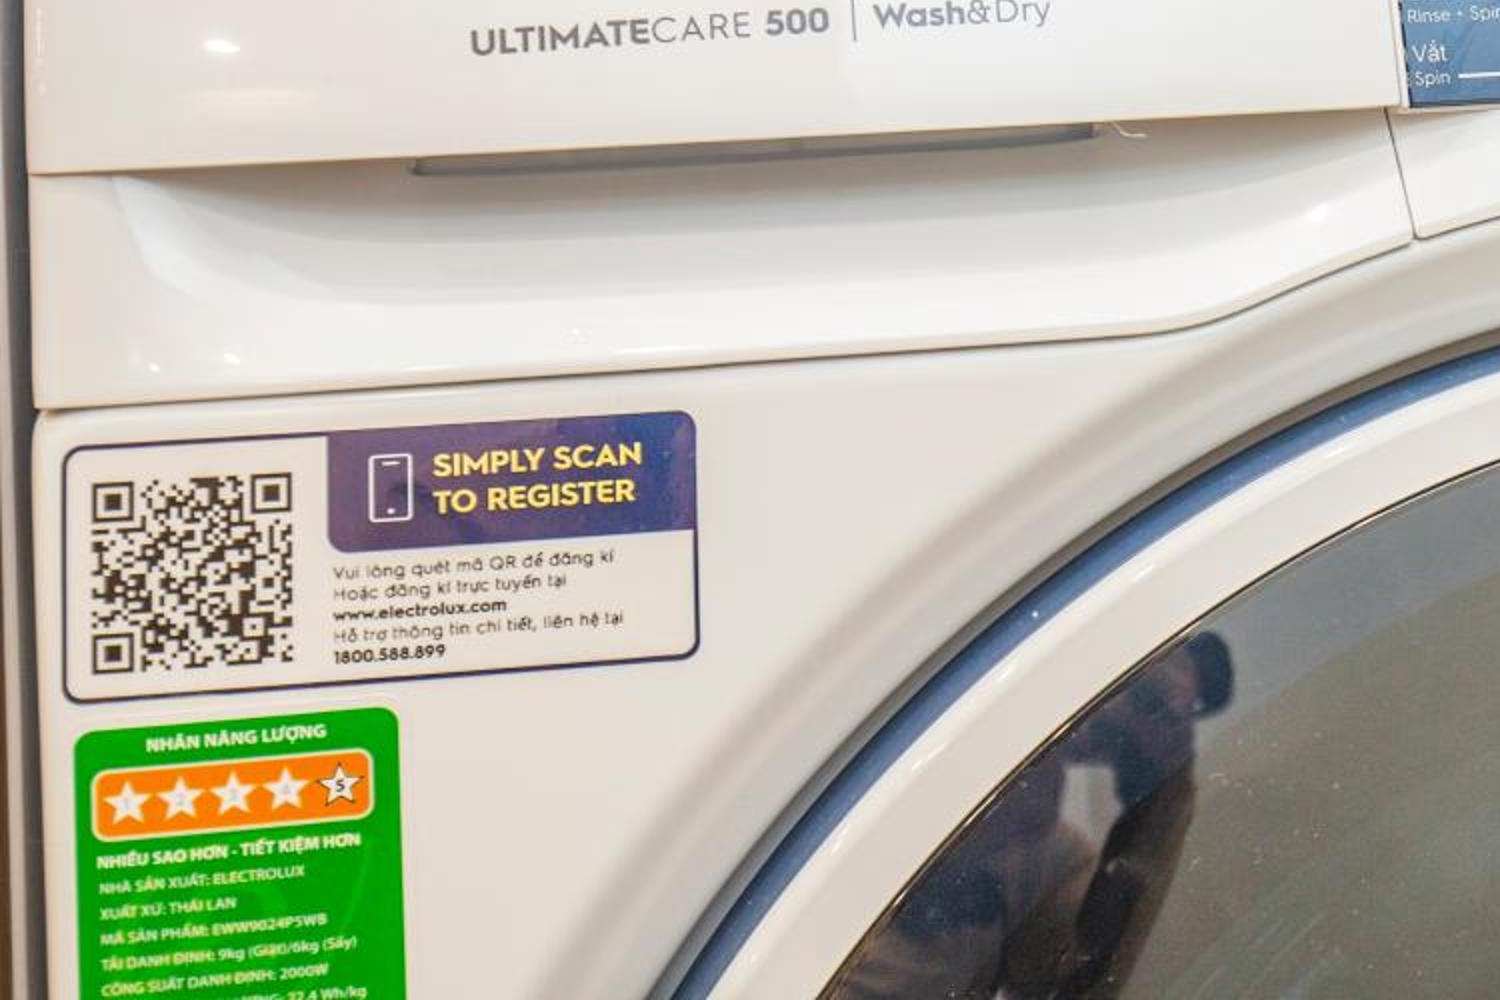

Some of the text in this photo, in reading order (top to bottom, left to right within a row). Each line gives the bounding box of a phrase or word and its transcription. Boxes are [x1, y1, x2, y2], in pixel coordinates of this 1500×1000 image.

[1407, 9, 1452, 23] Rinse
[470, 6, 830, 56] ULTIMATECARE 500
[1415, 71, 1451, 88] Spin
[432, 441, 642, 478] SIMPLY SCAN
[432, 478, 637, 515] TO REGISTER
[333, 566, 360, 580] Vui
[366, 563, 405, 580] lòng
[411, 561, 450, 578] quét
[456, 558, 483, 572] mã
[489, 555, 517, 570] QR
[333, 588, 378, 602] Hoặc
[333, 599, 507, 622] www.electrolux.com
[392, 625, 444, 641] thông
[449, 621, 470, 636] tin
[475, 620, 500, 635] chi
[579, 612, 599, 628] hệ
[333, 643, 447, 665] 1800.588.899
[261, 723, 327, 744] LƯỢNG
[152, 848, 187, 866] SAO
[190, 844, 229, 862] HƠN
[240, 837, 275, 856] TIẾT
[278, 836, 321, 855] KIỆM
[323, 832, 362, 849] HƠN
[212, 864, 305, 885] ELECTROLUX
[170, 898, 204, 914] THÁI
[207, 897, 238, 911] LAN
[126, 952, 171, 969] DANH
[218, 947, 246, 963] 9kg
[187, 972, 233, 989] DANH
[279, 963, 330, 980] 2000W
